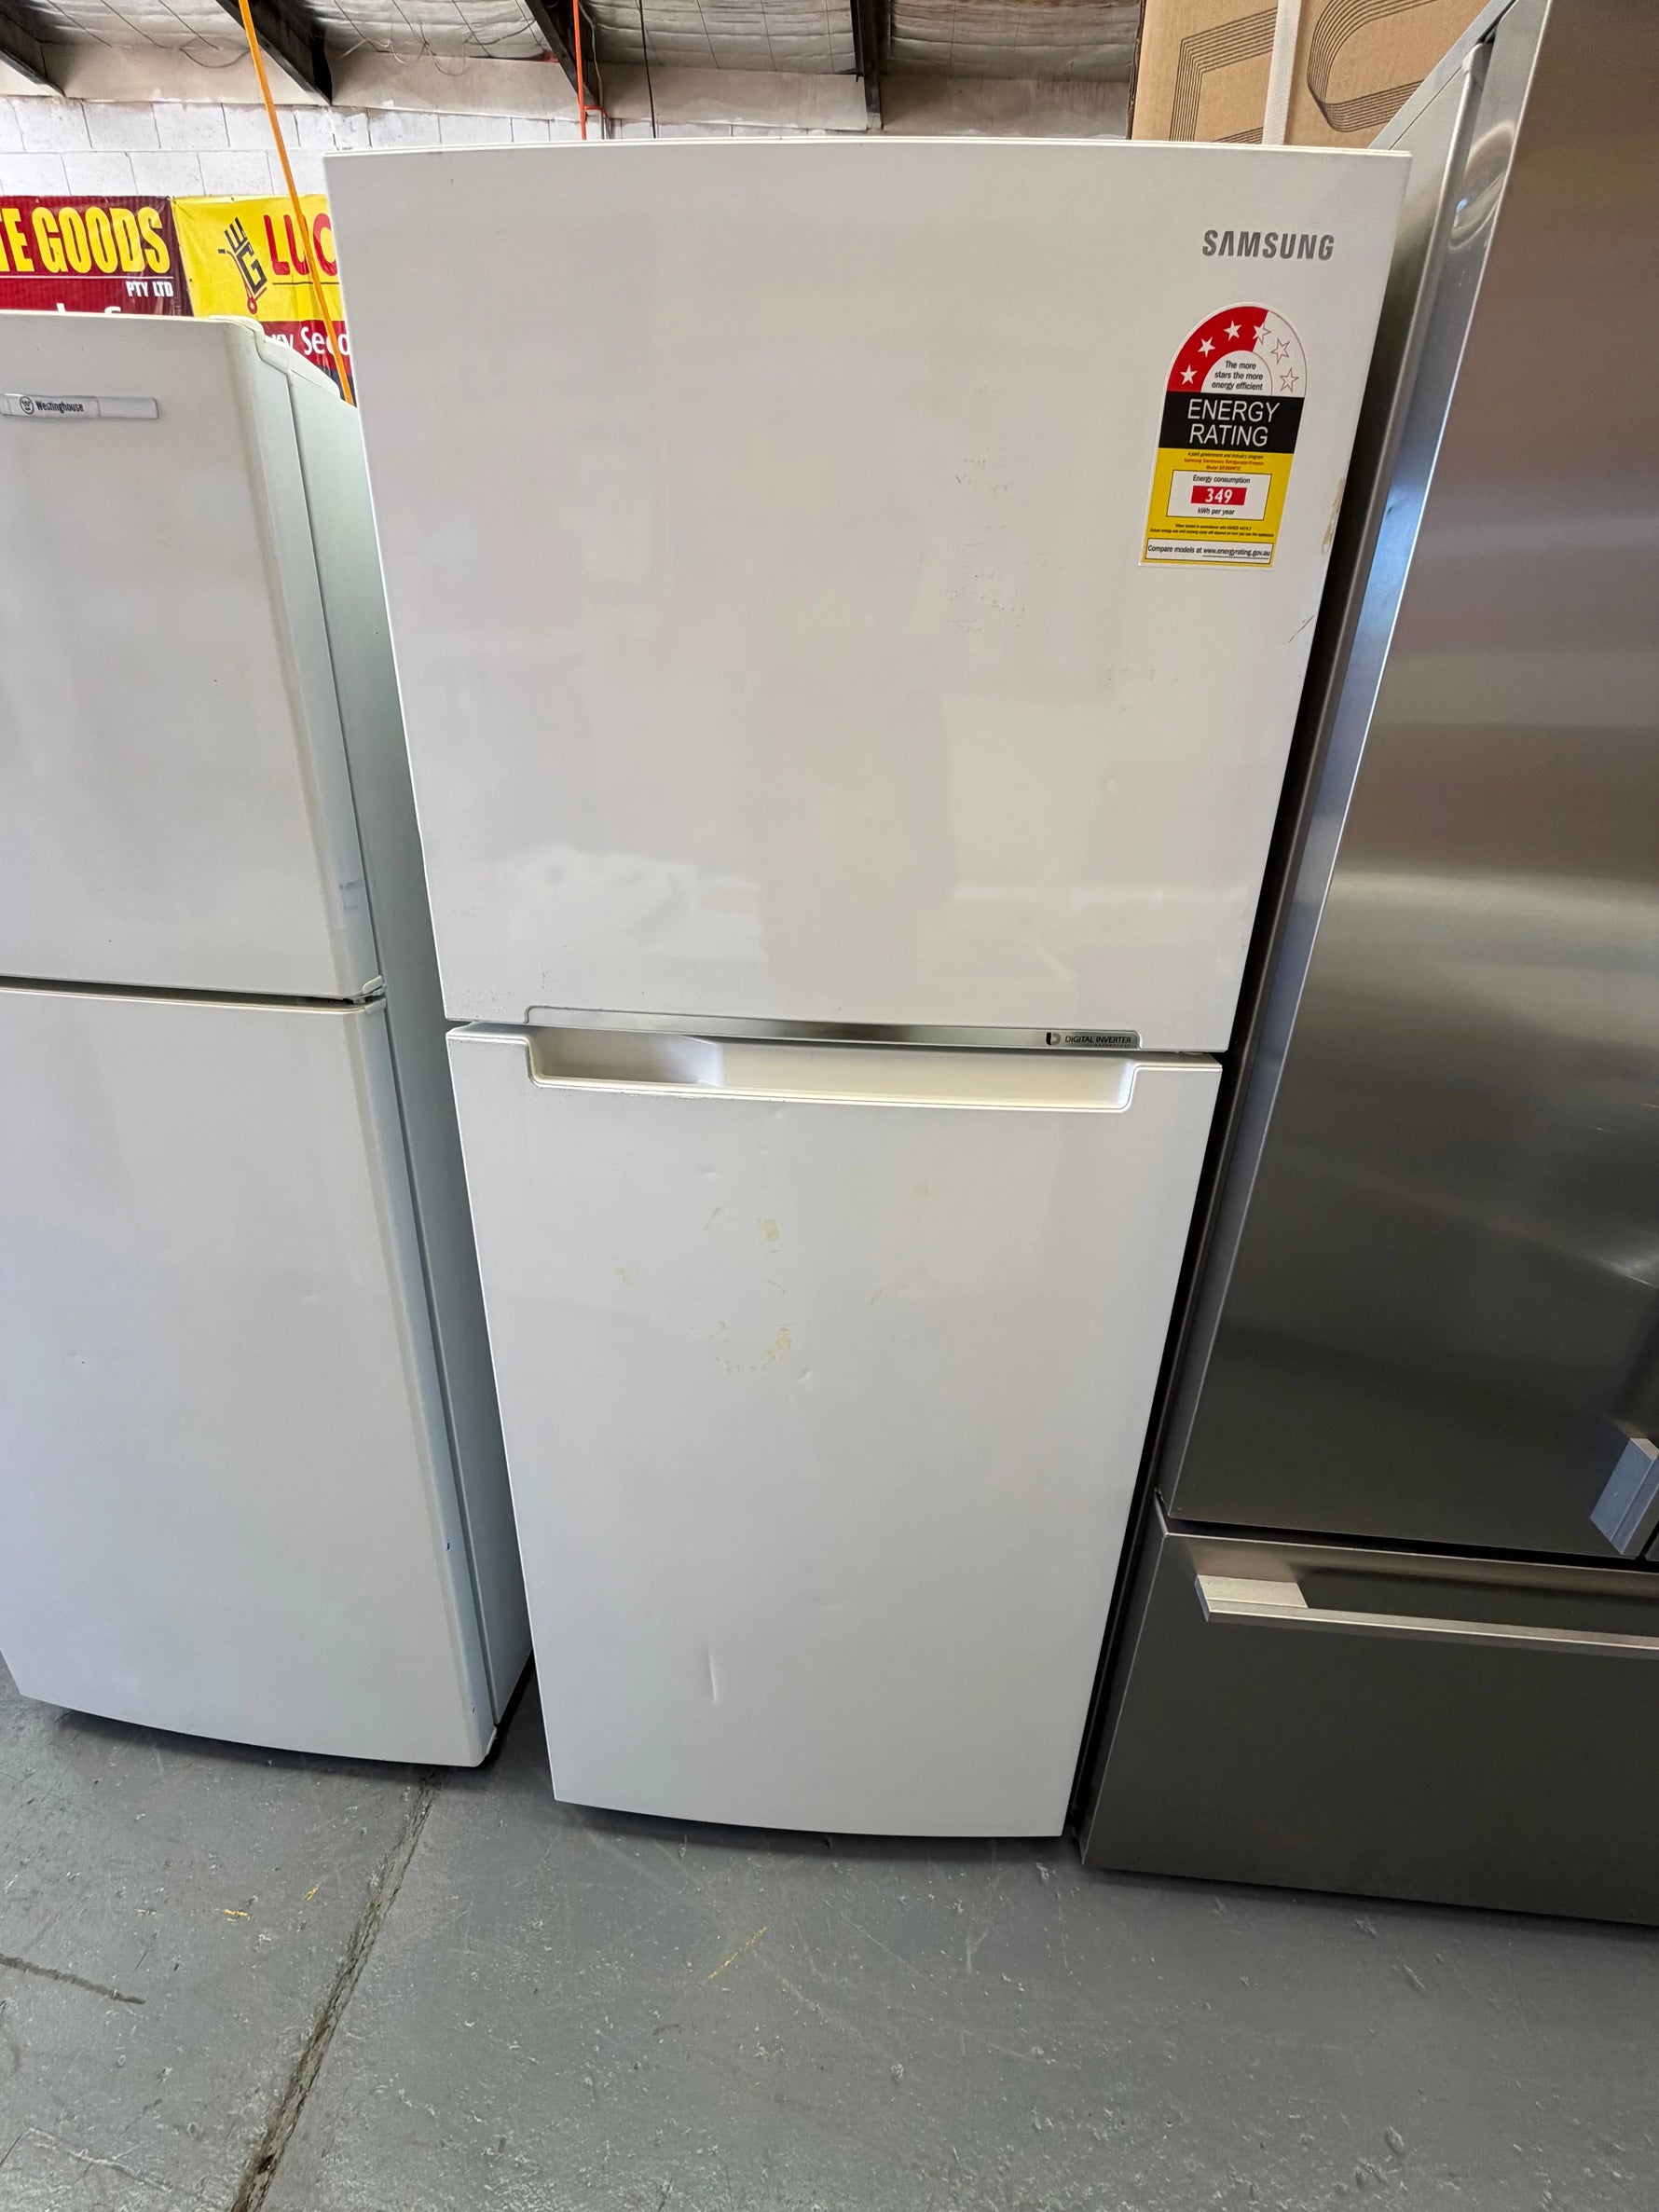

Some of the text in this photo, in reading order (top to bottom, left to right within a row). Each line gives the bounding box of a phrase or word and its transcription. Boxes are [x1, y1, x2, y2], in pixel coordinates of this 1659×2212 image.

[32, 206, 171, 274] GOODS
[1202, 229, 1335, 261] SAMSUNG
[126, 281, 174, 297] PTY LTD
[1225, 360, 1238, 369] The
[1214, 371, 1232, 379] stars
[1233, 371, 1244, 379] the
[1212, 382, 1264, 391] energy efficient
[35, 400, 85, 414] Westinghouse
[1187, 398, 1280, 422] ENERGY
[1189, 423, 1268, 447] RATING
[1193, 474, 1251, 484] Energy consumption
[1205, 488, 1233, 503] 349
[1147, 544, 1173, 554] Compare
[1174, 545, 1195, 554] models
[1203, 546, 1270, 557] www.energyrating.gov.au
